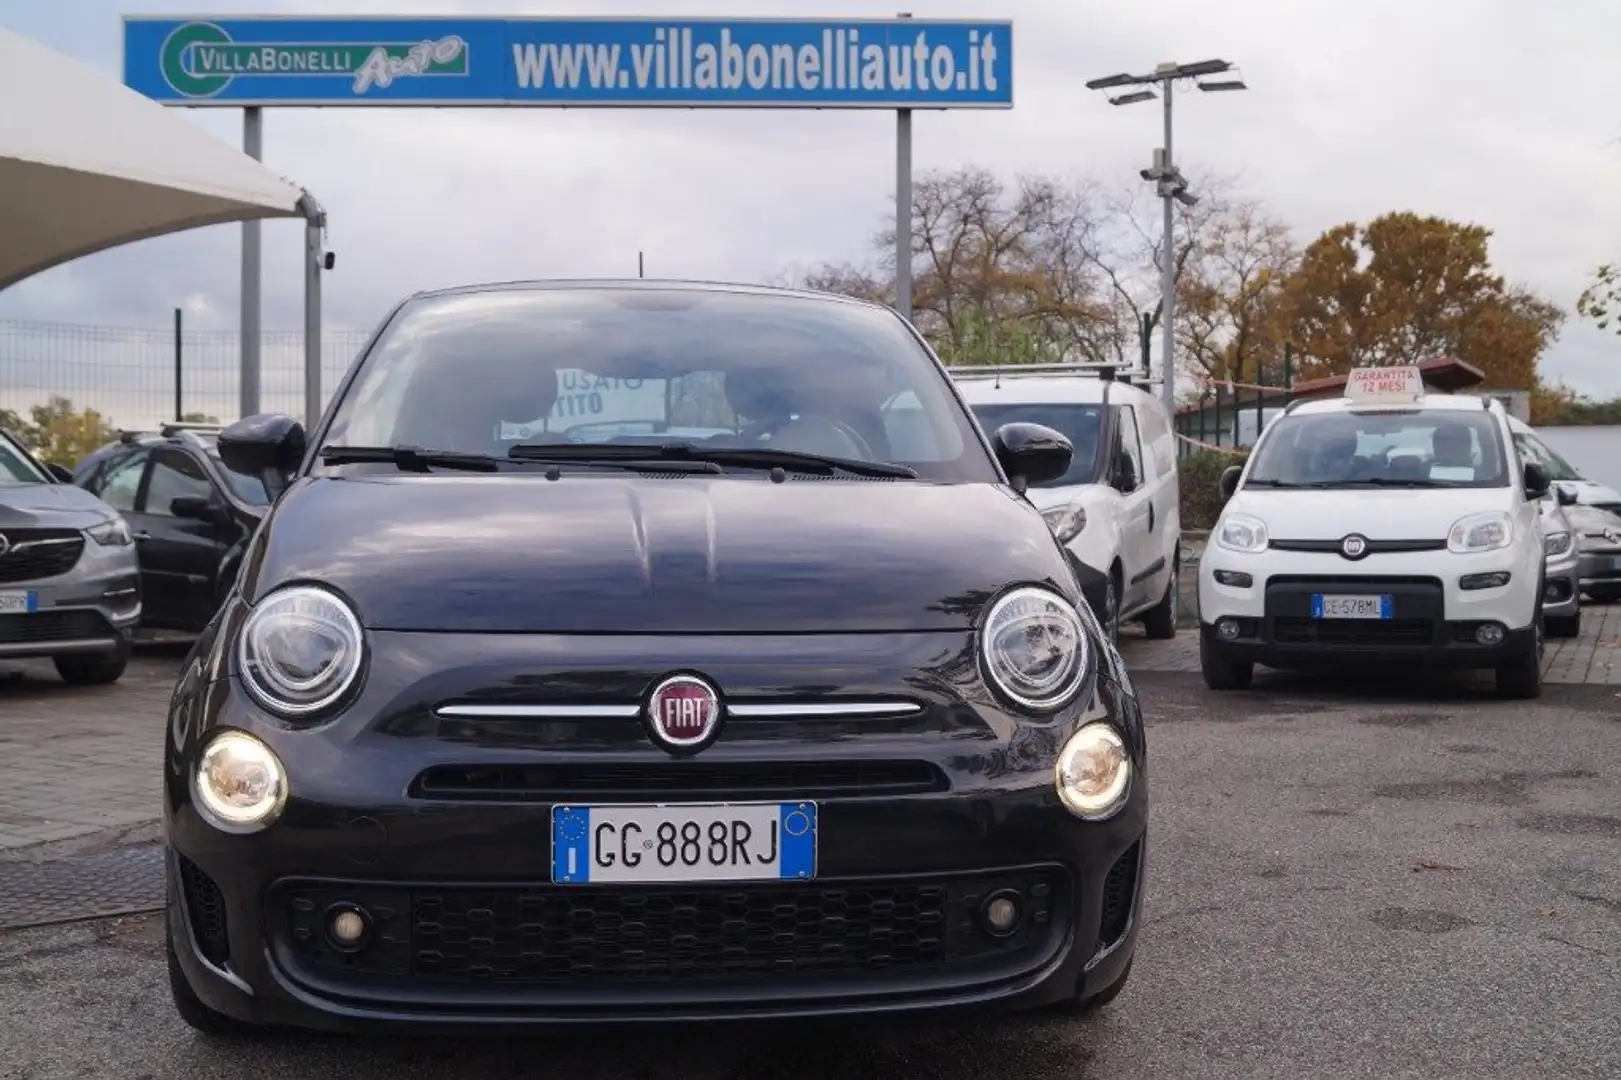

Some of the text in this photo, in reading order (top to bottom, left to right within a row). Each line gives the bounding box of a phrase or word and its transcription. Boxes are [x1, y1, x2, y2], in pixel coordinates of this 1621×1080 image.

[512, 28, 998, 92] www.villabonelliauto.it
[1378, 380, 1407, 393] MESI
[665, 698, 705, 728] FIAT
